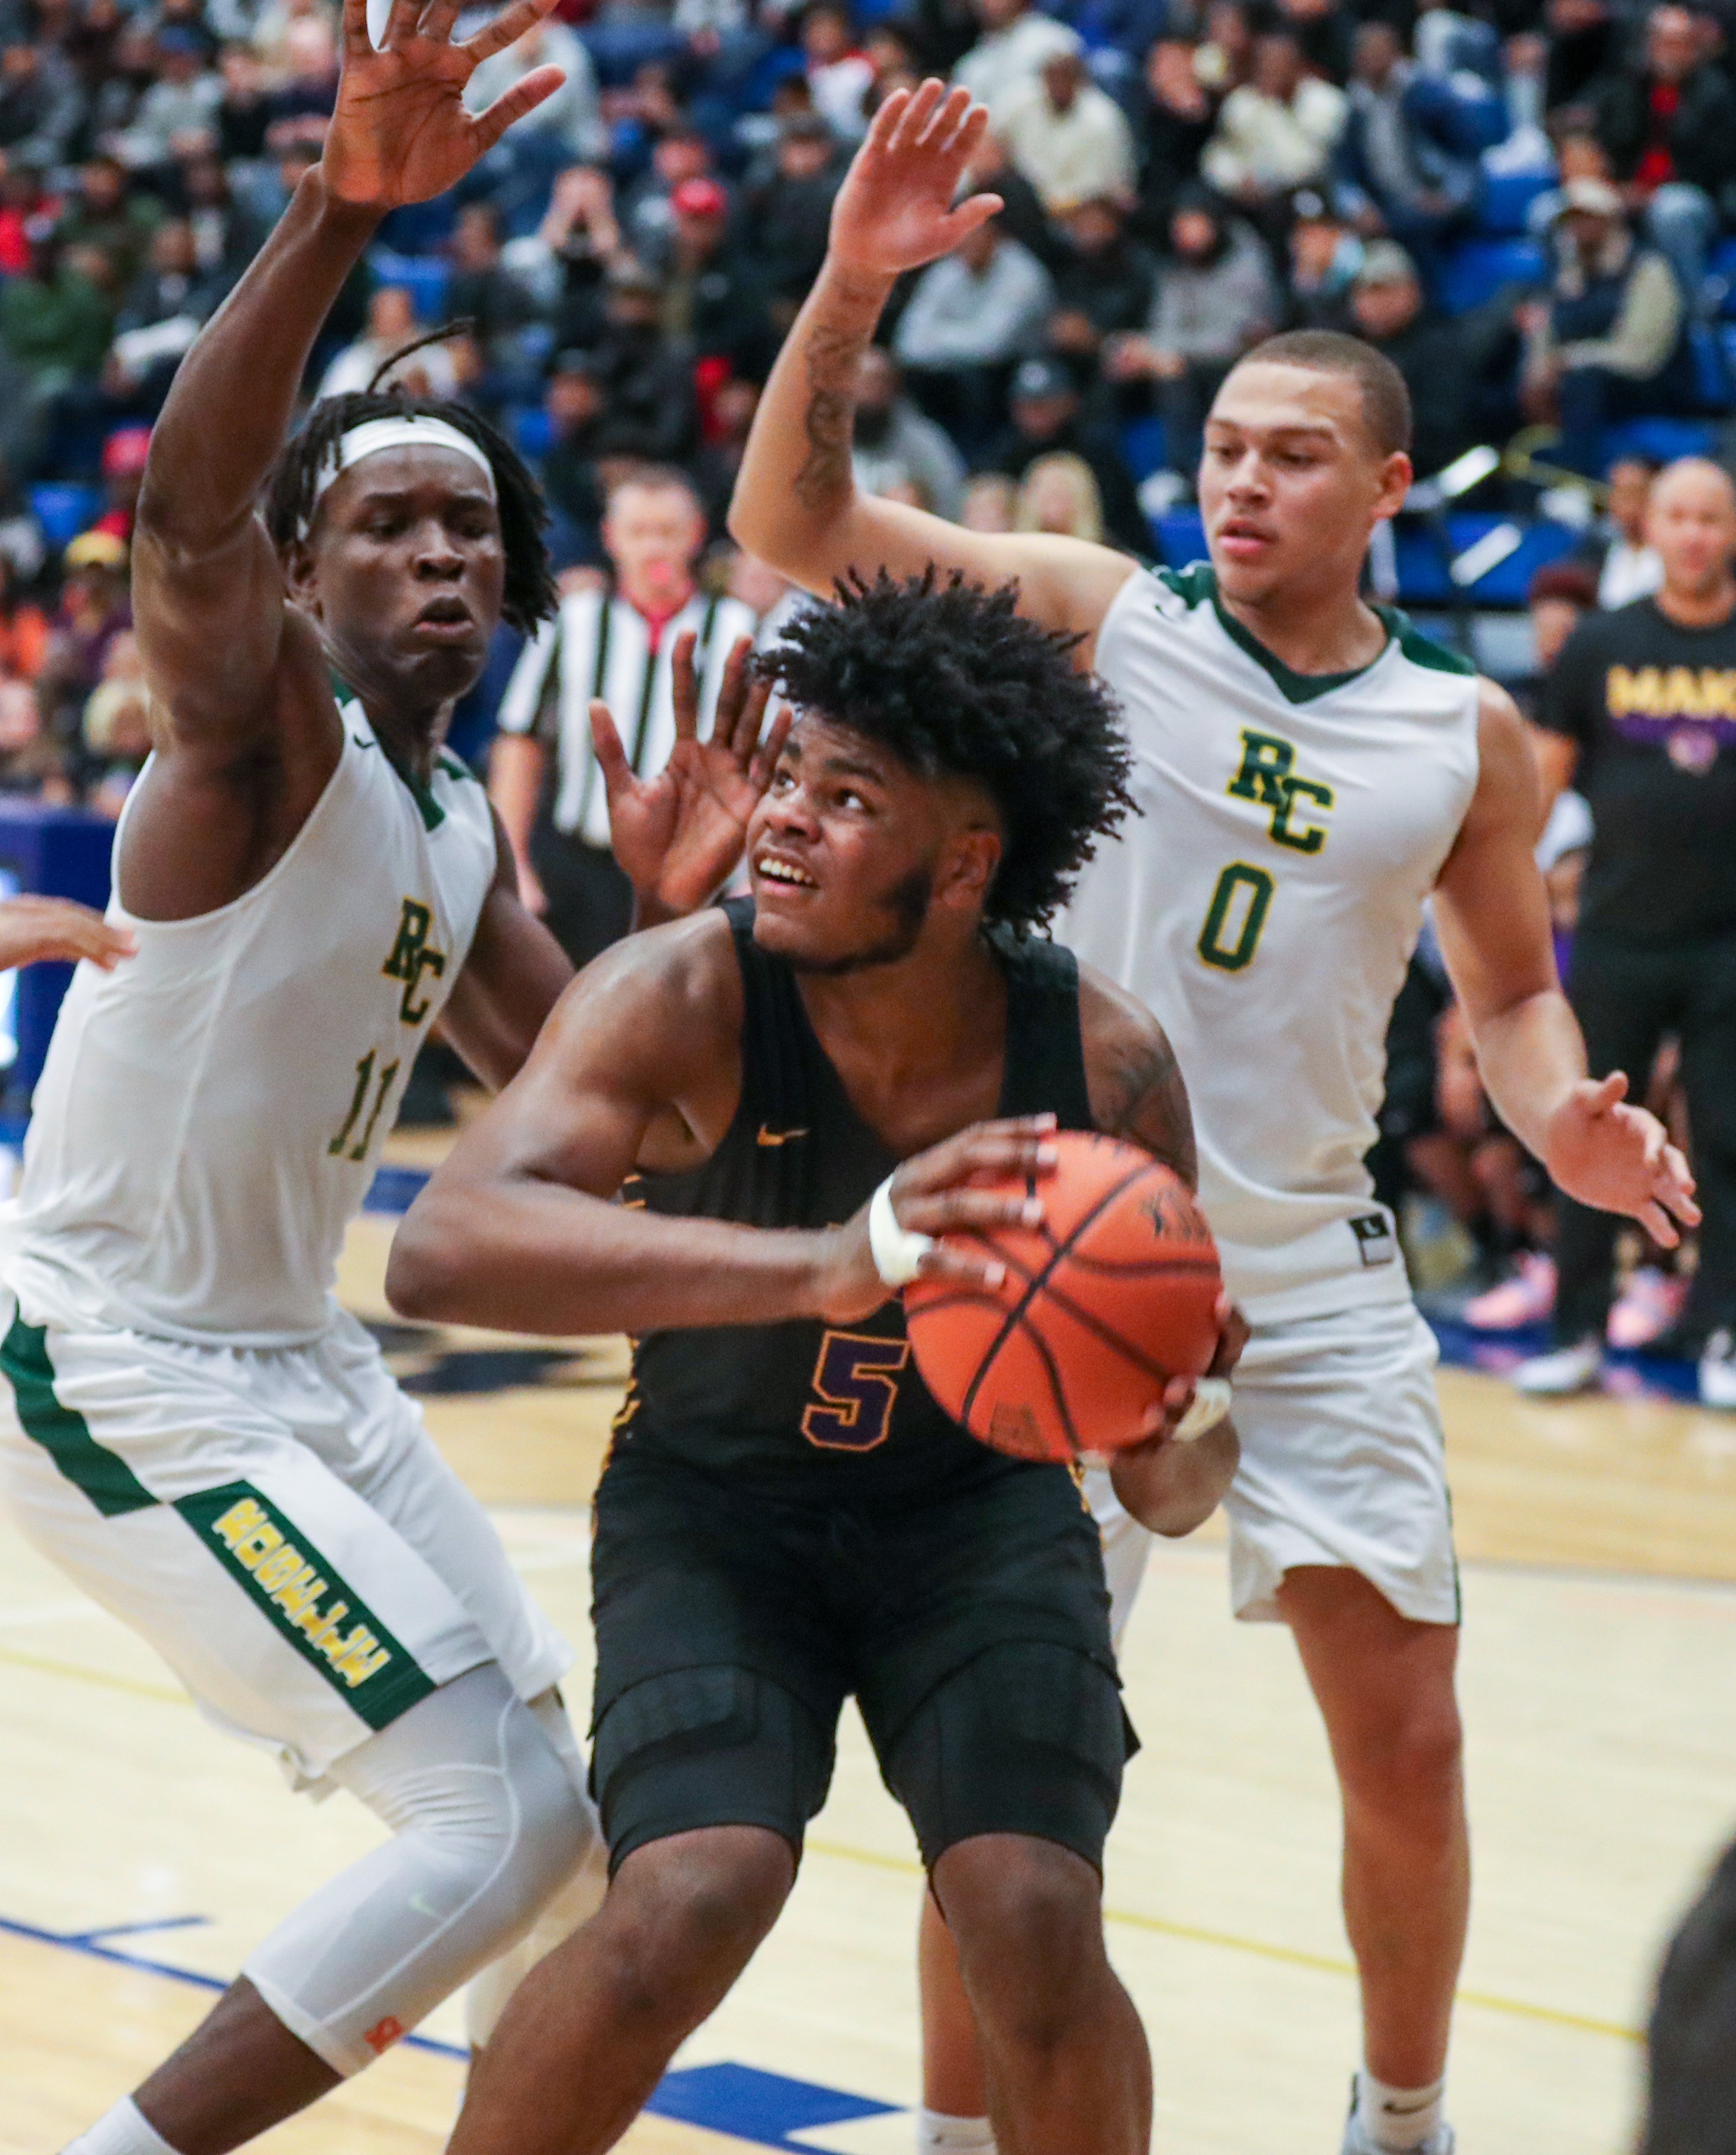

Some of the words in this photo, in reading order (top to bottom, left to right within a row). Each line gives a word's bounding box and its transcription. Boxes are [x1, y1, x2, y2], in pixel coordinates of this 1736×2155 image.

[1225, 727, 1334, 855] RC
[379, 894, 446, 1025] RC
[1196, 860, 1277, 972] 0
[328, 1049, 399, 1160] 11
[800, 1331, 911, 1451] 5
[211, 1497, 391, 1688] ROSELLE
